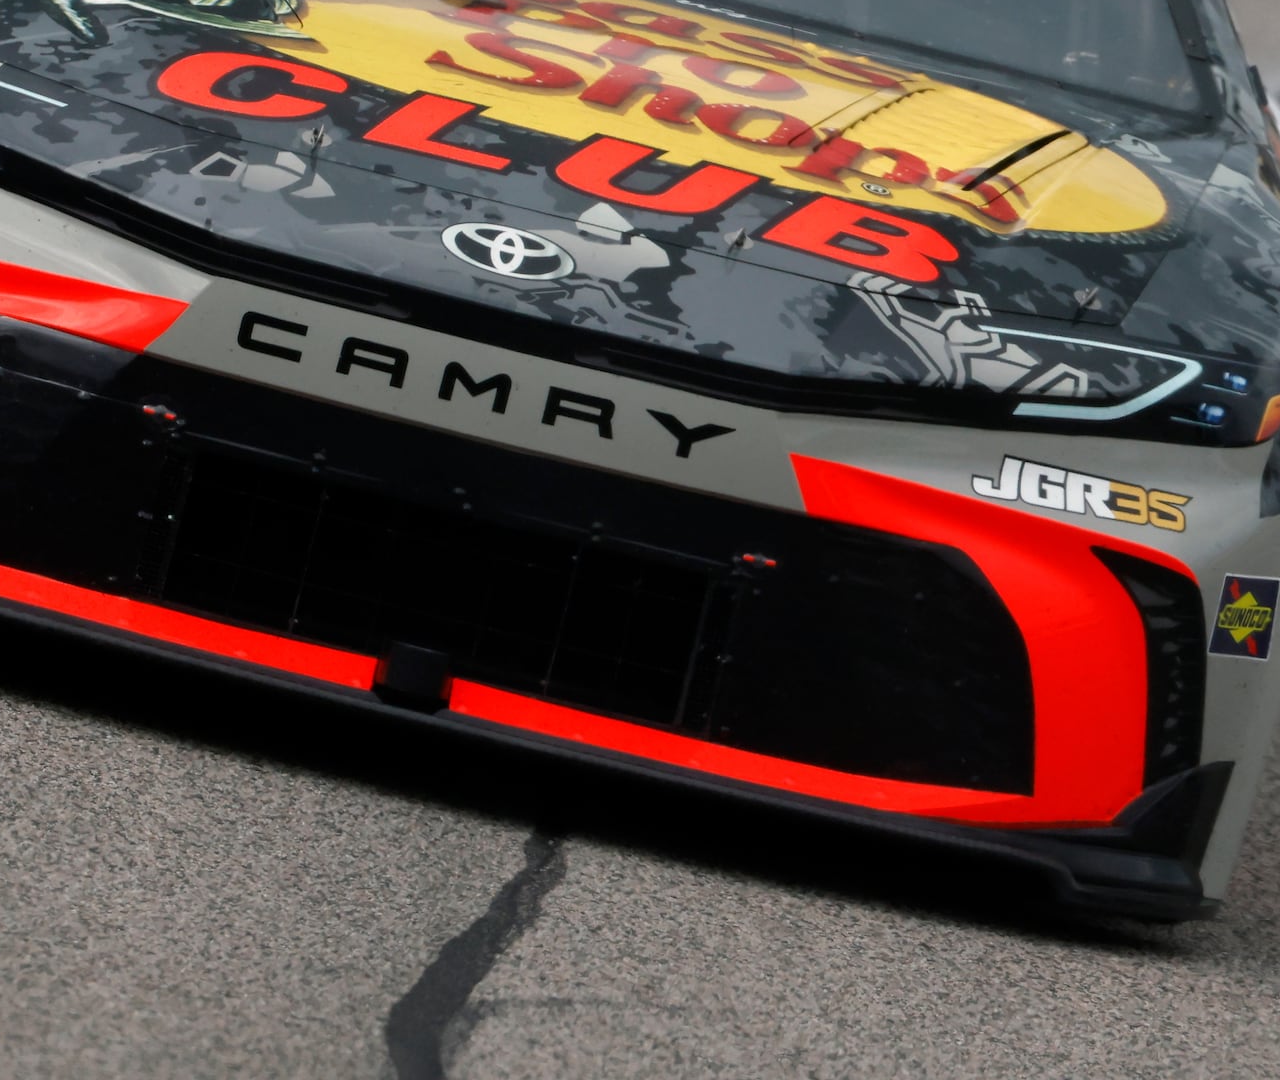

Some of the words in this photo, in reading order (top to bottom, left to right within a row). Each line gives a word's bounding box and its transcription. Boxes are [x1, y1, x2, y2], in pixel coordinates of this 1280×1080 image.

[157, 51, 960, 283] CLUB
[424, 32, 1028, 224] Shops
[237, 311, 736, 458] CAMRY
[1221, 605, 1268, 630] SUNOCO
